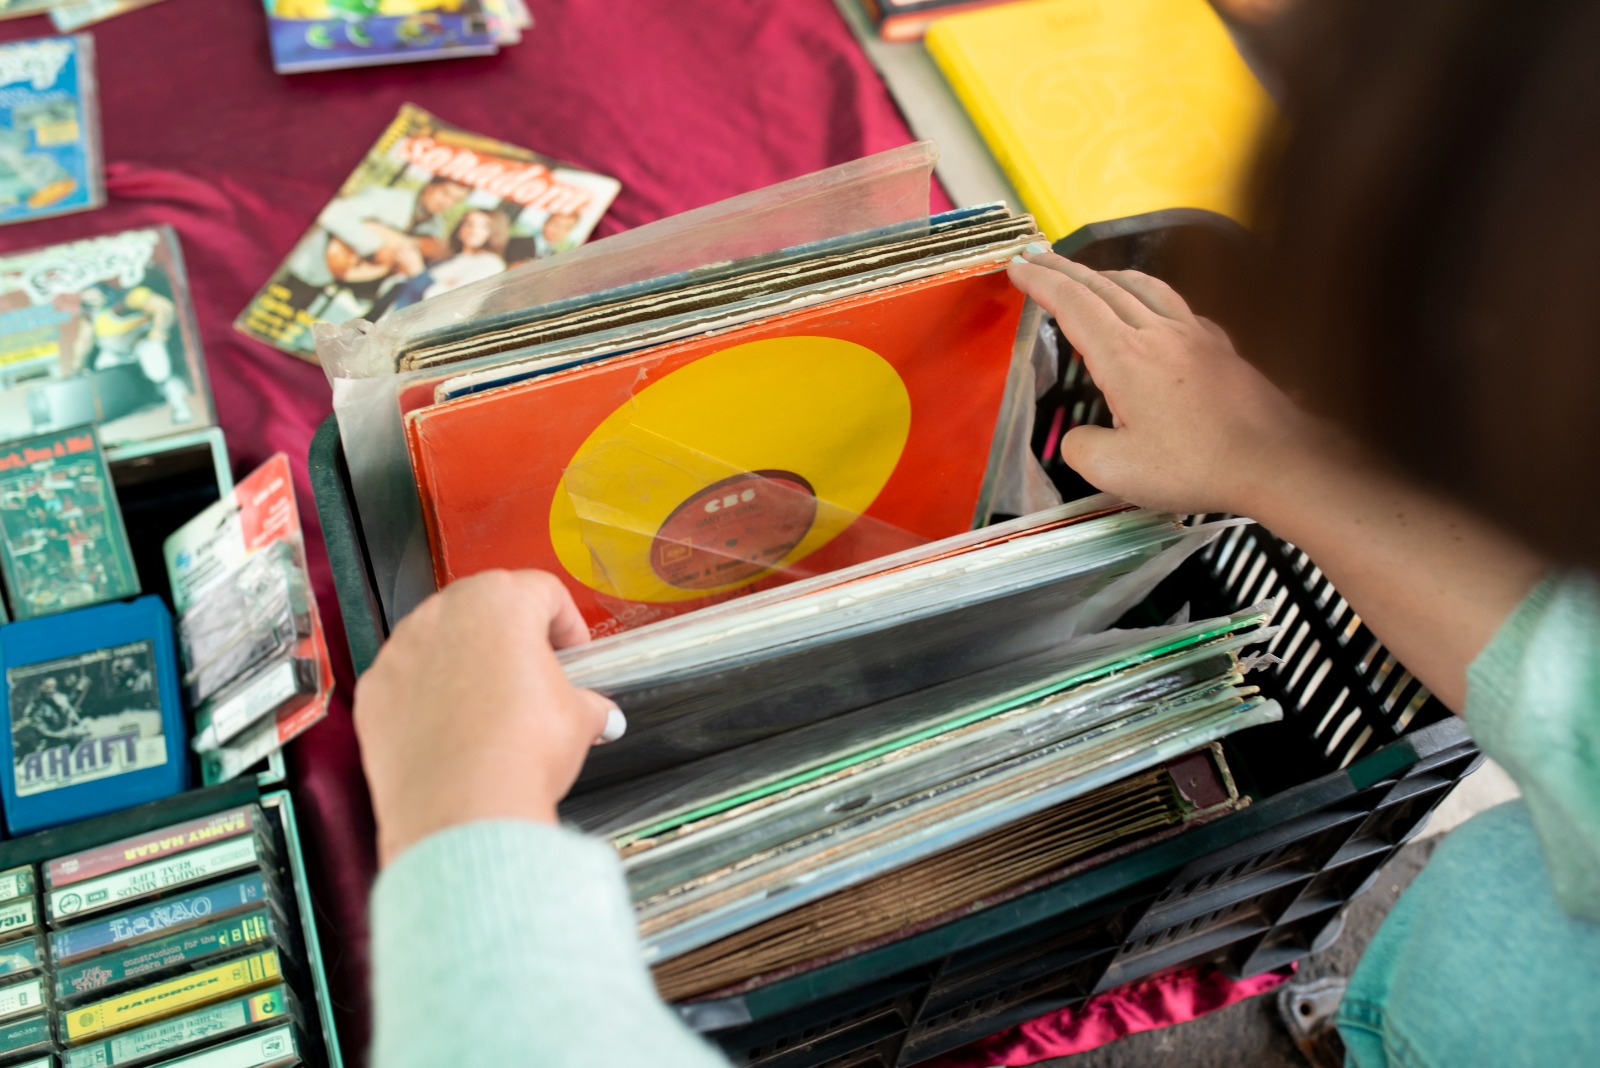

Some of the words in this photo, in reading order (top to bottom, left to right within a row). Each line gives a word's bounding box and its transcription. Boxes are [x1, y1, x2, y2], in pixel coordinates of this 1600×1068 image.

[703, 488, 756, 513] CBS
[123, 836, 184, 860] HAGAR
[127, 870, 155, 885] LIFE
[158, 859, 191, 877] REAL
[160, 864, 206, 885] SIMPLE
[115, 878, 157, 898] MINDS
[122, 943, 183, 968] construction
[183, 938, 199, 950] for
[199, 933, 216, 945] the
[123, 958, 162, 977] modern
[162, 951, 185, 965] idiot
[135, 1031, 184, 1052] BONHAM
